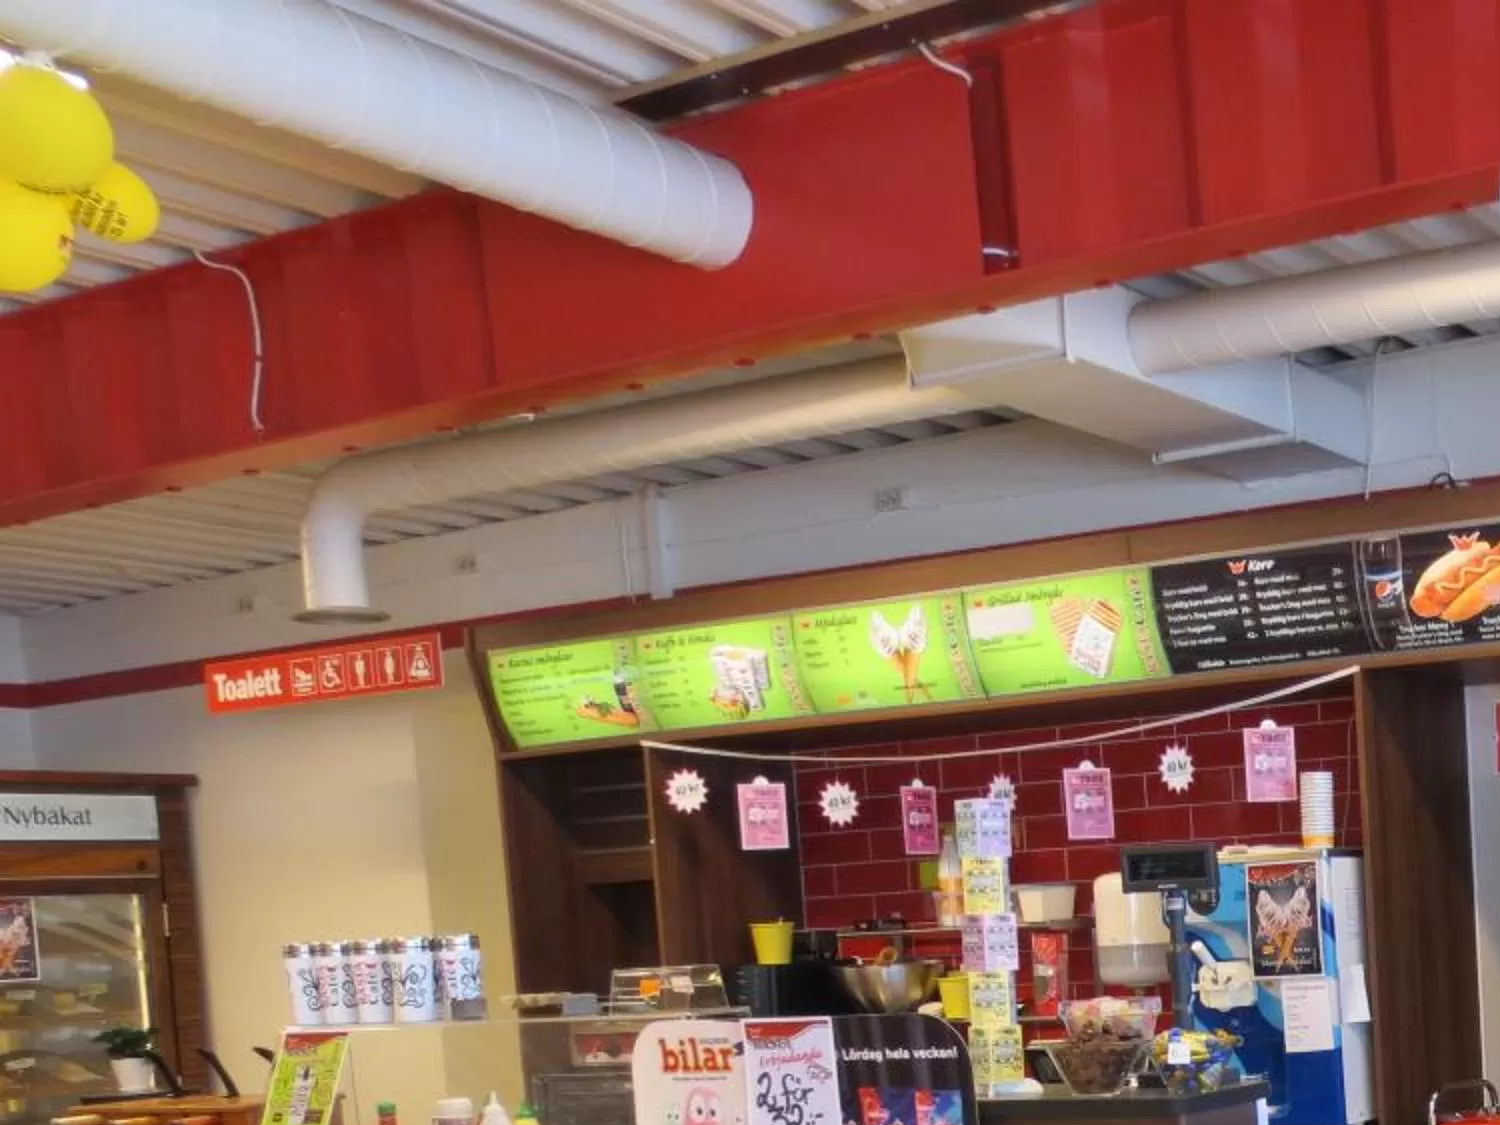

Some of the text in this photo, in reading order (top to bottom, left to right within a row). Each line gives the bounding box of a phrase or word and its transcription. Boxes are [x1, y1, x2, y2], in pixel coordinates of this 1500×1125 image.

[212, 667, 283, 703] Toalett
[3, 805, 92, 829] Nybakat
[658, 1037, 734, 1074] bilar
[842, 1047, 958, 1062] Lördag hela veckan!
